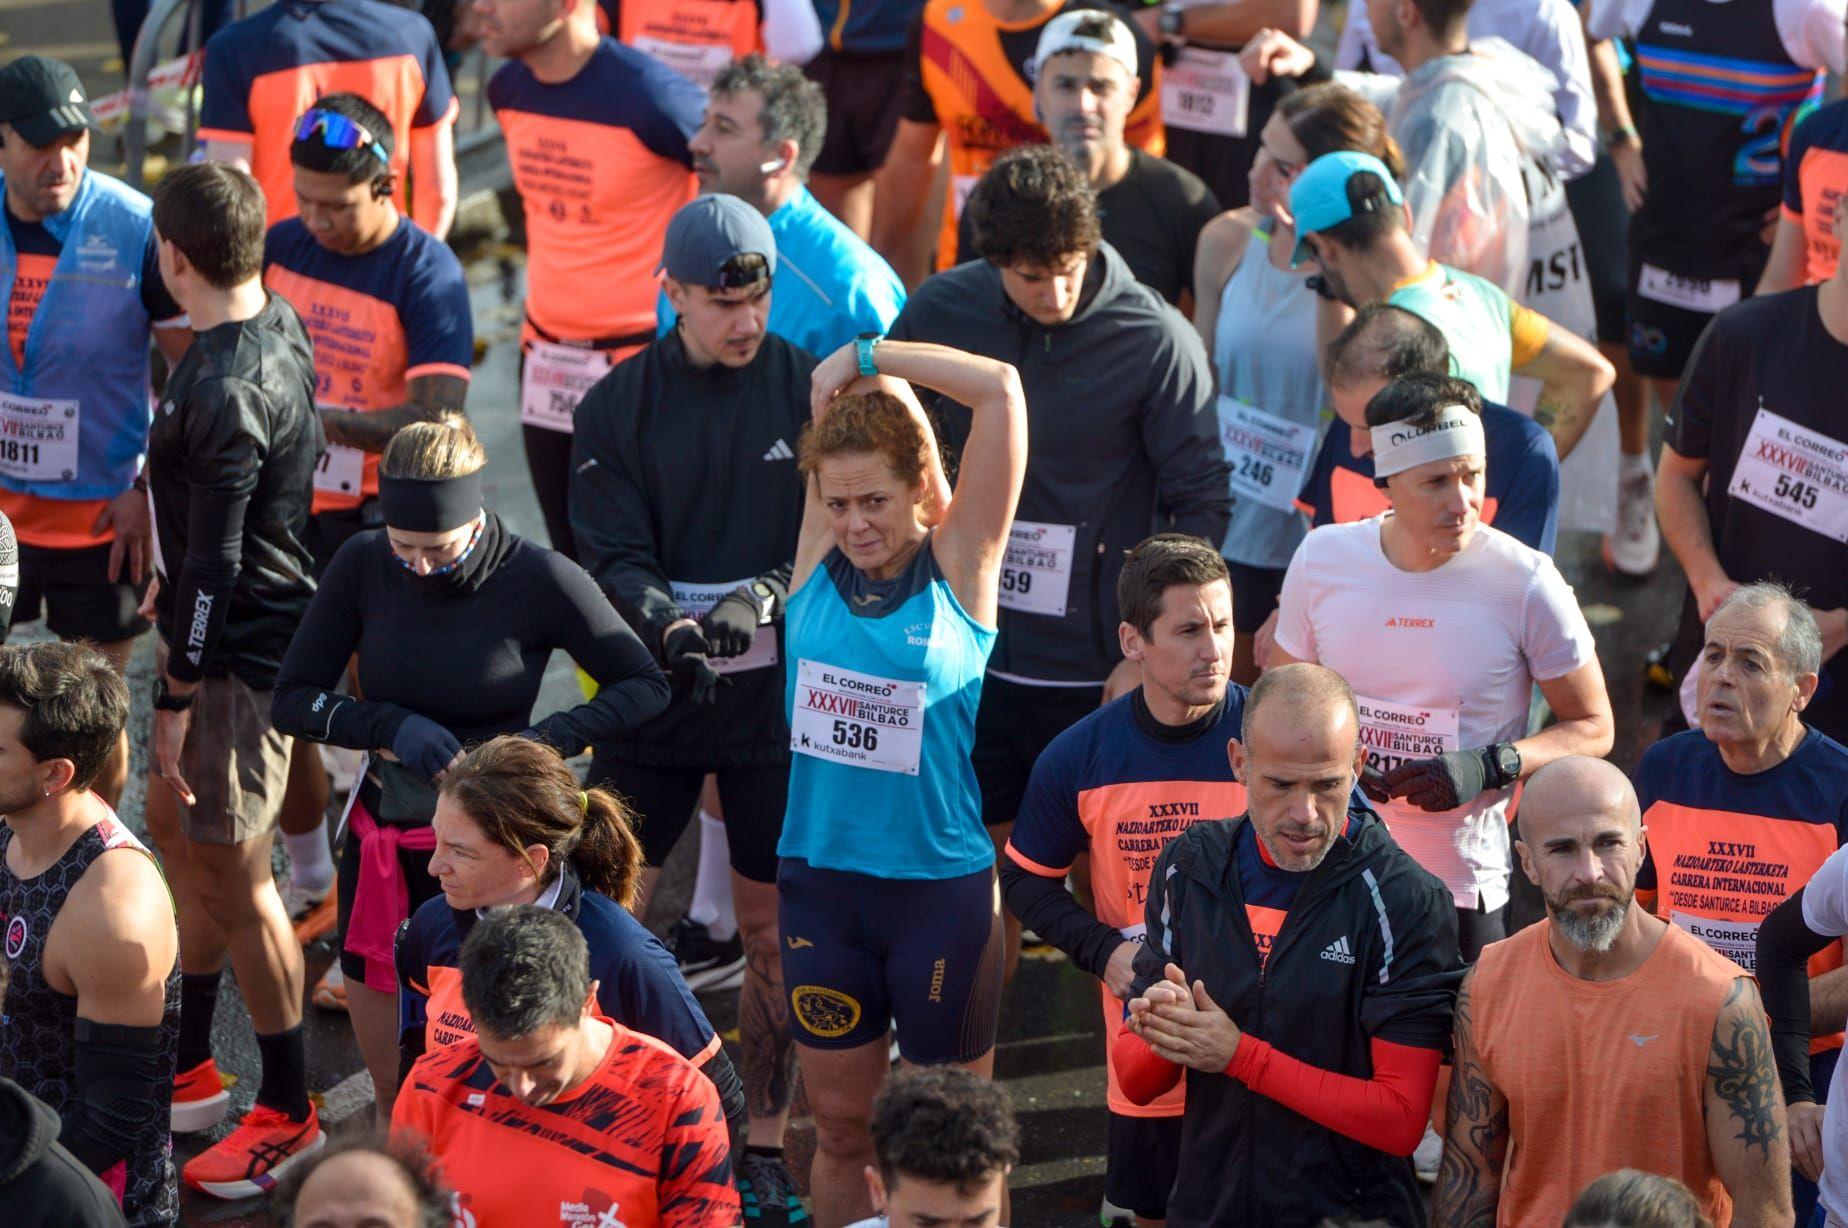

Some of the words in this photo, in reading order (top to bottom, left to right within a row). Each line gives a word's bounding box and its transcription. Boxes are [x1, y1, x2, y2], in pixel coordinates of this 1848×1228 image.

[0, 439, 39, 465] 1811
[1777, 428, 1791, 441] EL
[1794, 435, 1845, 462] CORREO
[1756, 438, 1808, 475] XXXVII
[1239, 454, 1274, 486] 246
[1774, 473, 1819, 510] 545
[676, 591, 687, 600] EL
[188, 588, 215, 649] TERREX
[1399, 617, 1435, 628] TERREX
[822, 673, 838, 685] EL
[839, 677, 892, 697] CORREO
[808, 689, 857, 717] XXXVII
[858, 701, 909, 717] SANTURCE
[858, 709, 909, 727] BILBAO
[1360, 706, 1372, 717] EL
[1374, 709, 1425, 726] CORREO
[832, 719, 878, 751] 536
[1393, 732, 1444, 745] SANTURCE
[814, 742, 867, 761] kutxabank
[1393, 741, 1444, 756] BILBAO
[1149, 803, 1199, 817] XXXVII
[1116, 818, 1179, 835] NAZIOARTEKO
[1118, 838, 1160, 852] CARRERA
[1708, 841, 1755, 858] XXXVII
[1673, 854, 1732, 873] NAZIOARTEKO
[1731, 860, 1789, 878] LASTERKETA
[1671, 872, 1711, 890] CARRERA
[1712, 876, 1786, 896] INTERNACIONAL
[1699, 895, 1740, 913] SANTURCE
[1741, 899, 1749, 913] A
[1691, 925, 1704, 937] EL
[1706, 929, 1758, 941] CORREO
[1320, 950, 1356, 964] adidas
